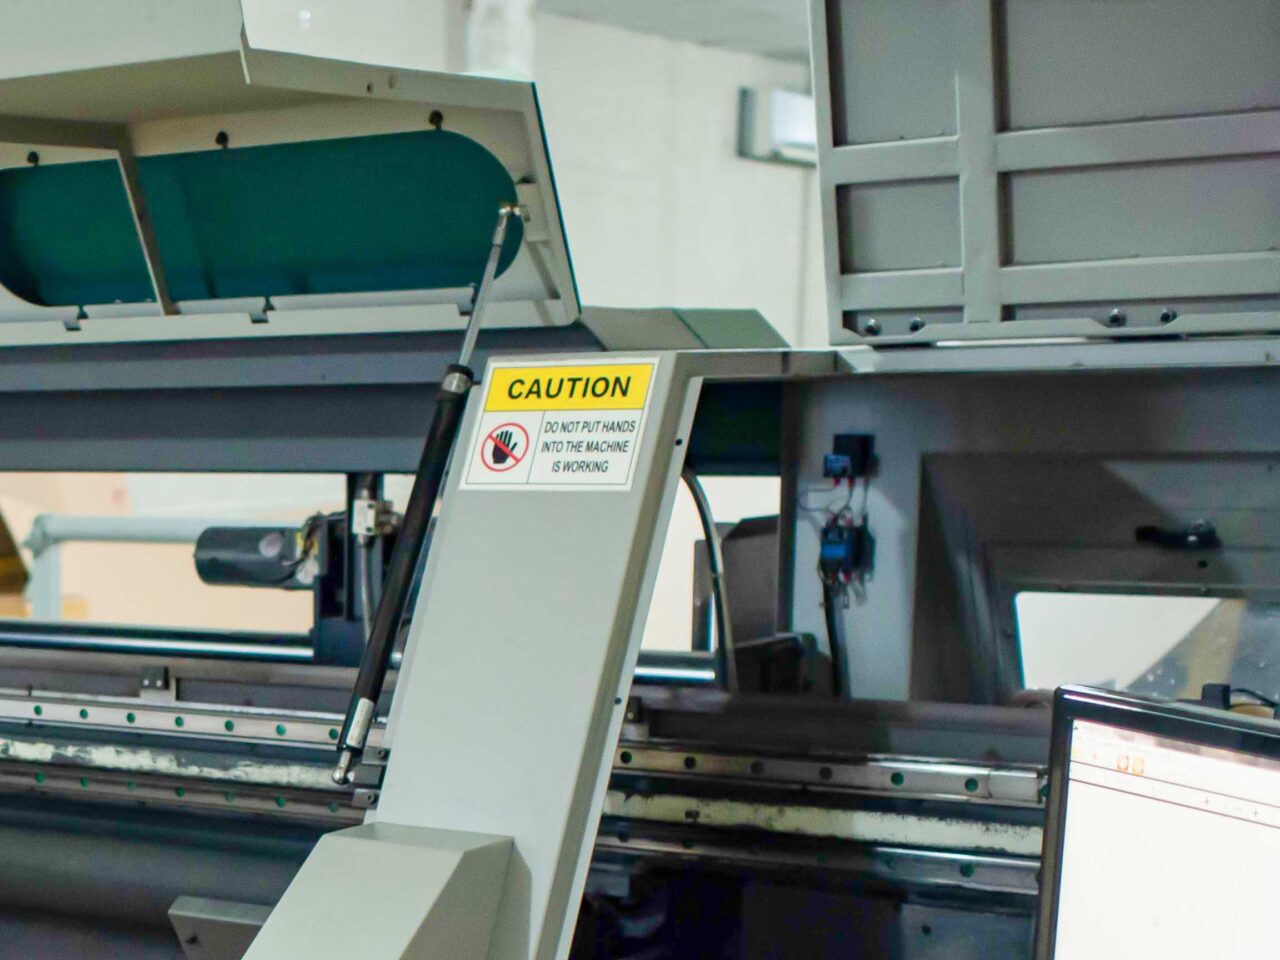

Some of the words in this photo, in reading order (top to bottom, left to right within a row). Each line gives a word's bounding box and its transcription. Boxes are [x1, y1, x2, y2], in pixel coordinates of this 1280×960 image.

[507, 376, 631, 399] CAUTION
[544, 421, 559, 433] DO
[561, 421, 581, 433] NOT
[582, 421, 601, 433] PUT
[602, 420, 636, 433] HANDS
[541, 441, 563, 453] INTO
[565, 441, 583, 453] THE
[585, 440, 629, 453] MACHINE
[552, 461, 561, 473] IS
[562, 460, 609, 473] WORKING
